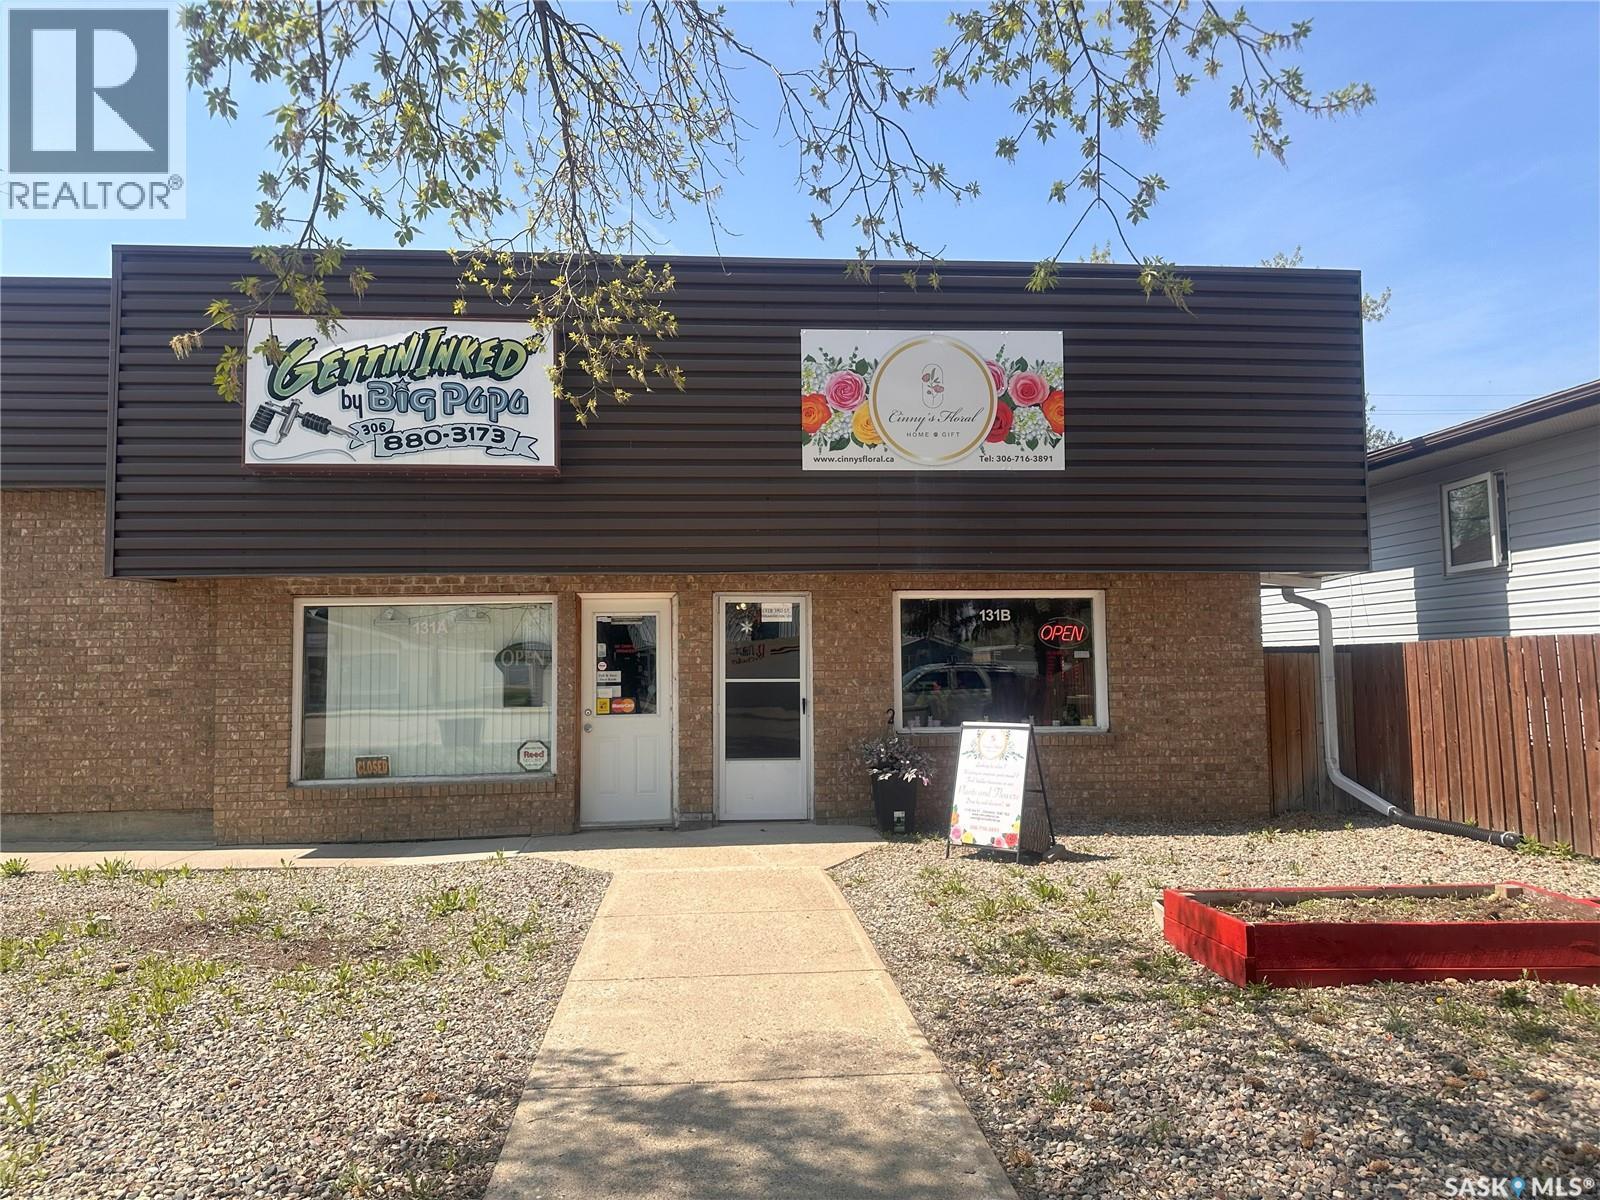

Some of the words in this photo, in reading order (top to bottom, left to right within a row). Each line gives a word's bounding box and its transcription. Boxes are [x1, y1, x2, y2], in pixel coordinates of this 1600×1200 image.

[342, 389, 363, 418] by
[367, 378, 436, 422] Big
[441, 382, 529, 422] Papa
[361, 421, 386, 435] 306
[888, 408, 936, 432] Cinny's
[937, 407, 985, 423] Floral
[383, 426, 506, 451] 880-3173
[813, 455, 895, 465] www.cinnysfloral.ca
[978, 455, 995, 463] Tel:
[995, 455, 1054, 463] 306-716-3891
[978, 609, 1011, 622] 131B
[413, 619, 449, 635] 131A
[1039, 625, 1085, 642] OPEN
[500, 649, 545, 667] OPEN
[356, 759, 388, 776] CLOSED
